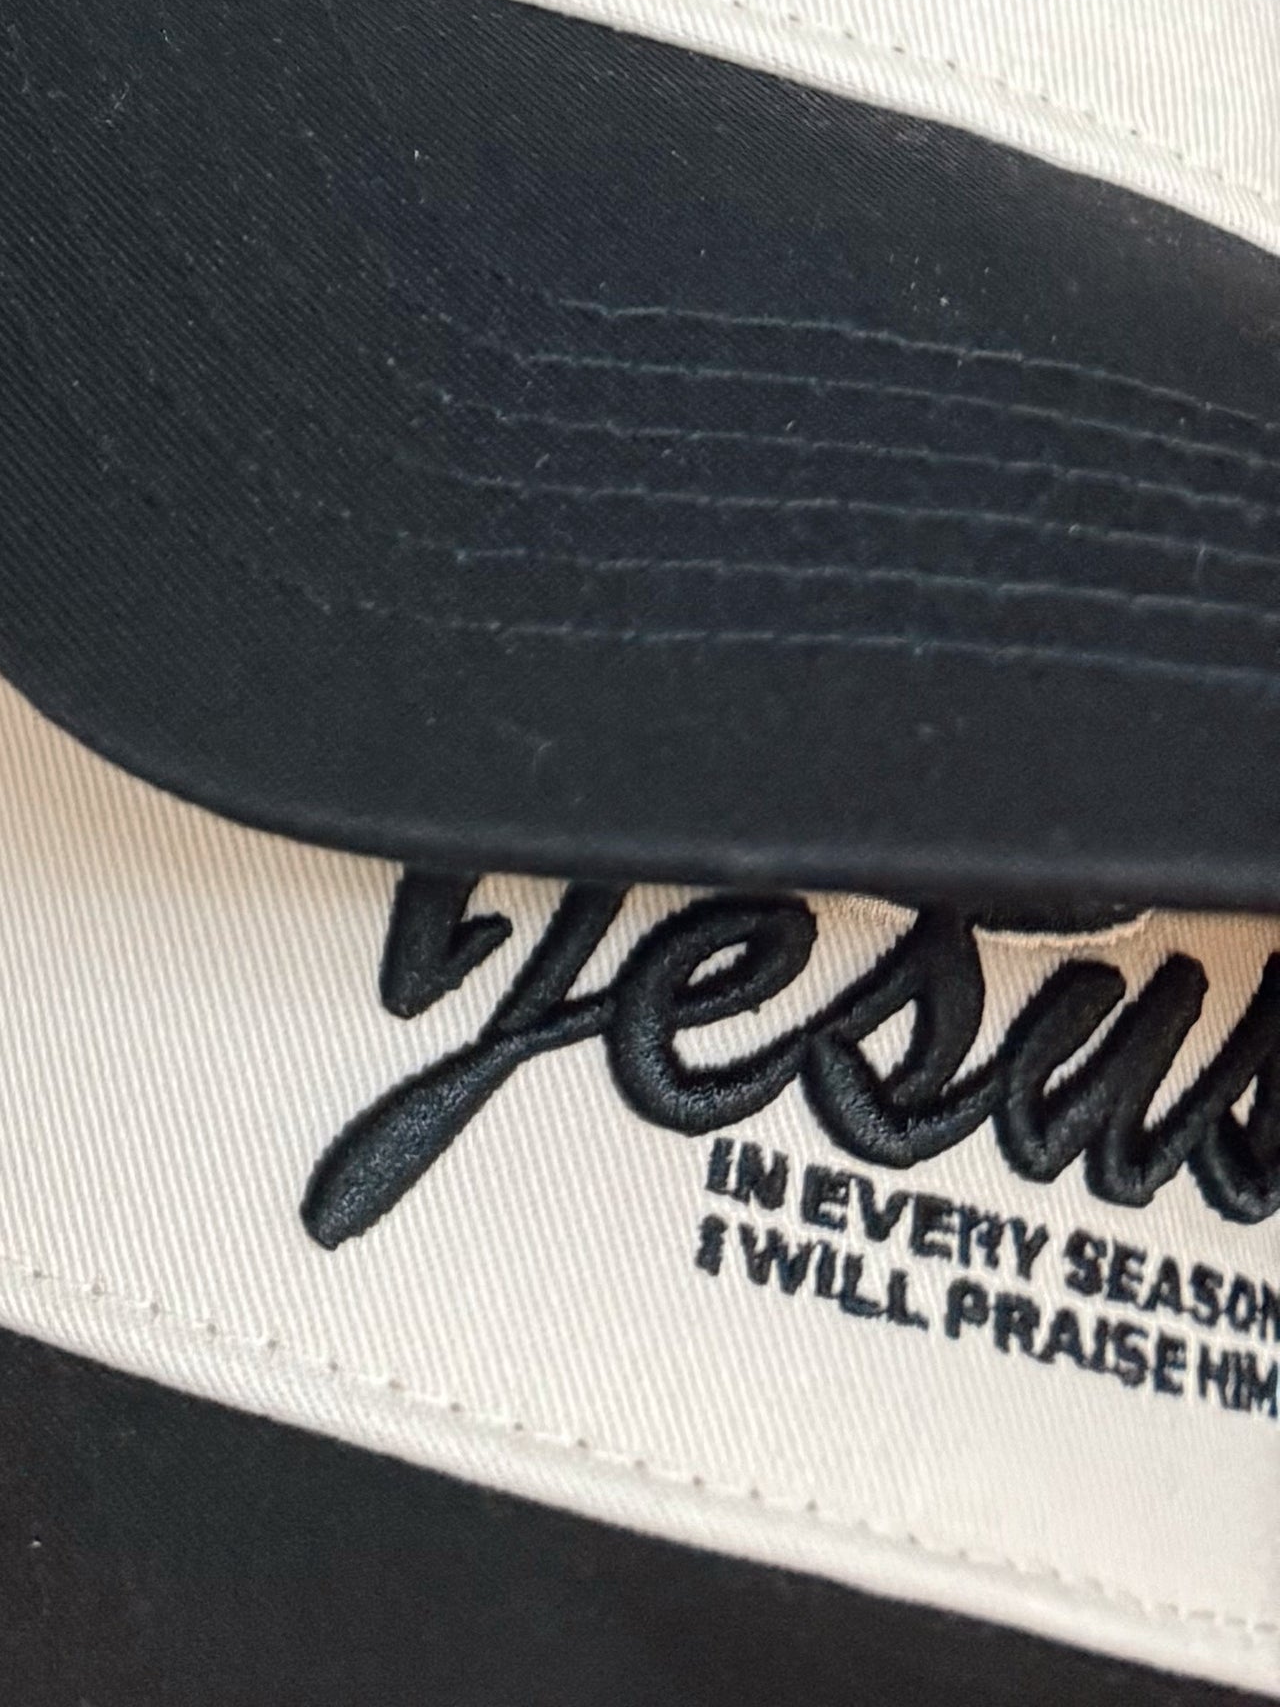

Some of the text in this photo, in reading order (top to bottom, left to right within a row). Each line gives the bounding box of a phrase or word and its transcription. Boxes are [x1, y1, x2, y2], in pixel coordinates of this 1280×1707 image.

[705, 1138, 788, 1210] IN
[801, 1165, 1050, 1281] EVERY
[696, 1214, 728, 1277] I
[738, 1223, 929, 1331] WILL
[945, 1278, 1187, 1395] PRAISE
